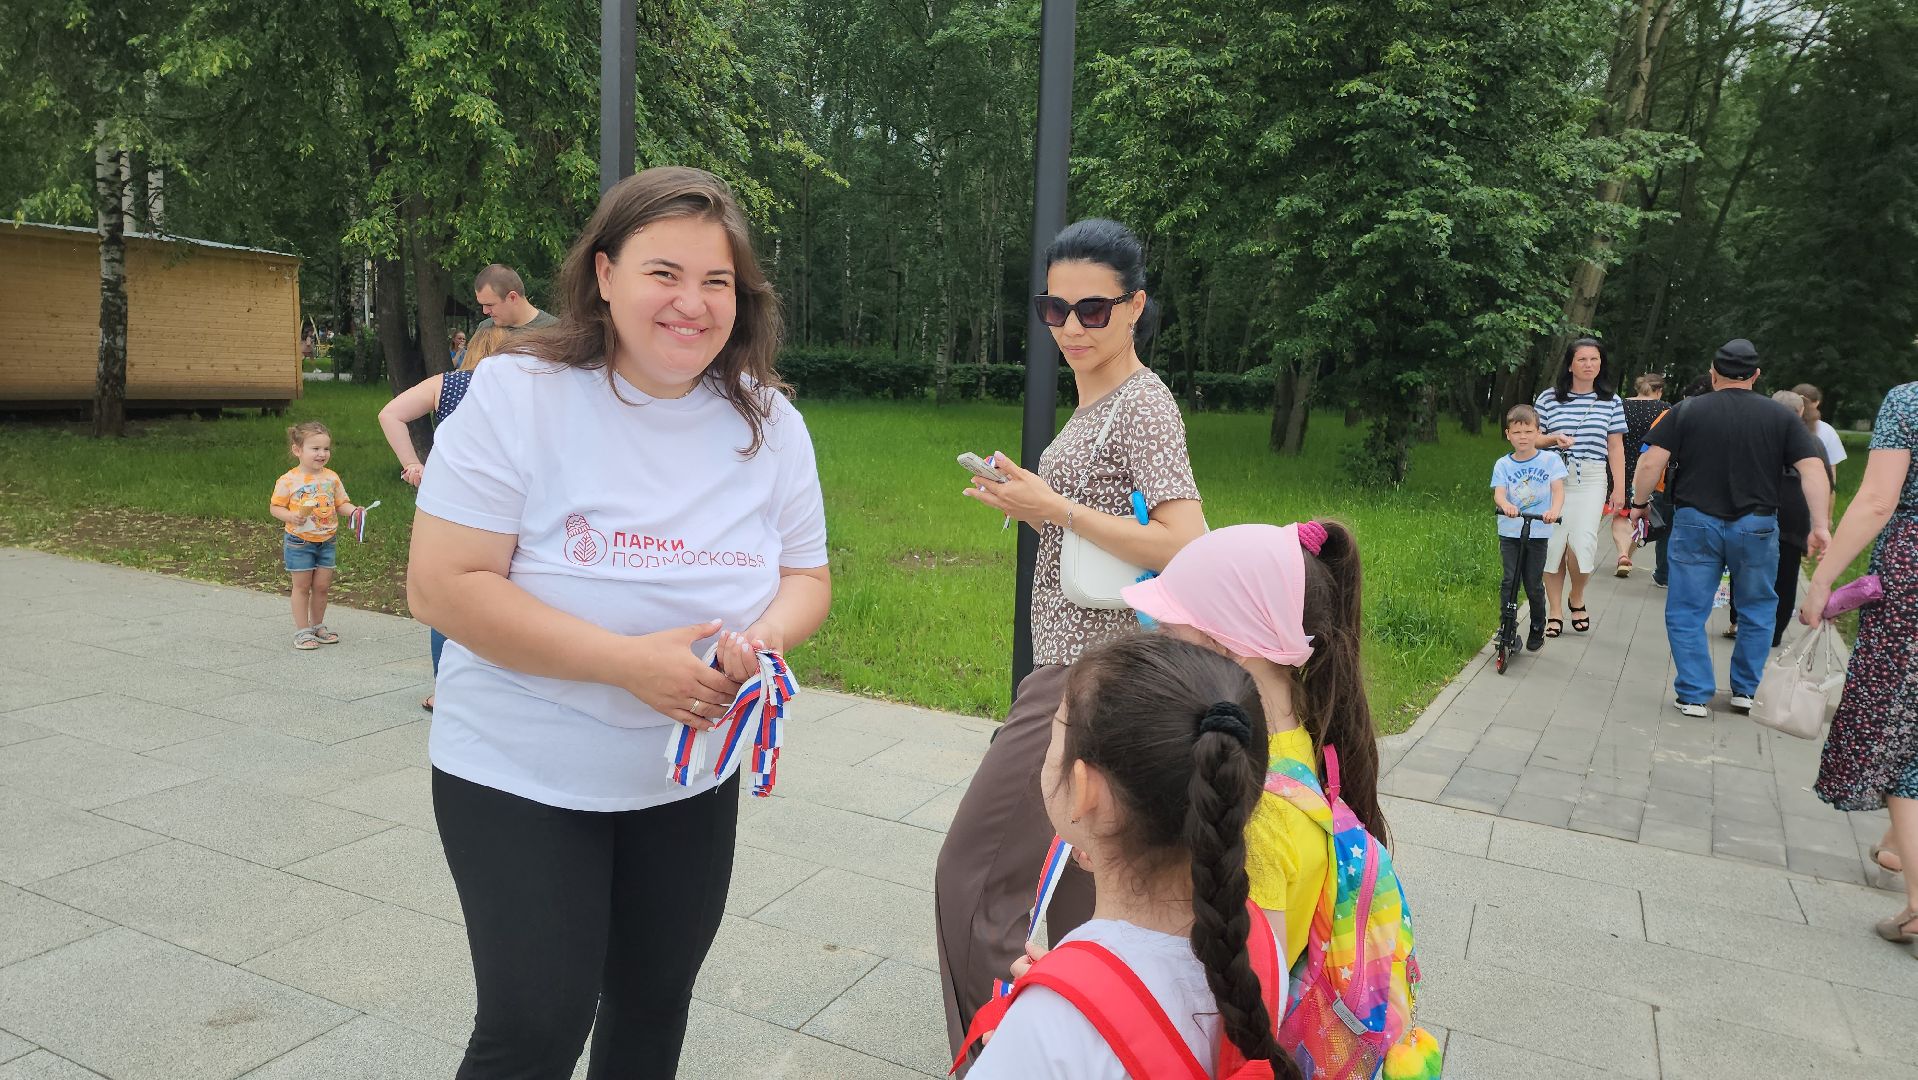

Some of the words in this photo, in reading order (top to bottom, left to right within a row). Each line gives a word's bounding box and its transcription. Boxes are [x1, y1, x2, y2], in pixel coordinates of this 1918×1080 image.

[1508, 467, 1549, 483] SURFING
[613, 531, 684, 551] ПАРКИ
[612, 551, 766, 568] ПОДМОСКОВЬЯ
